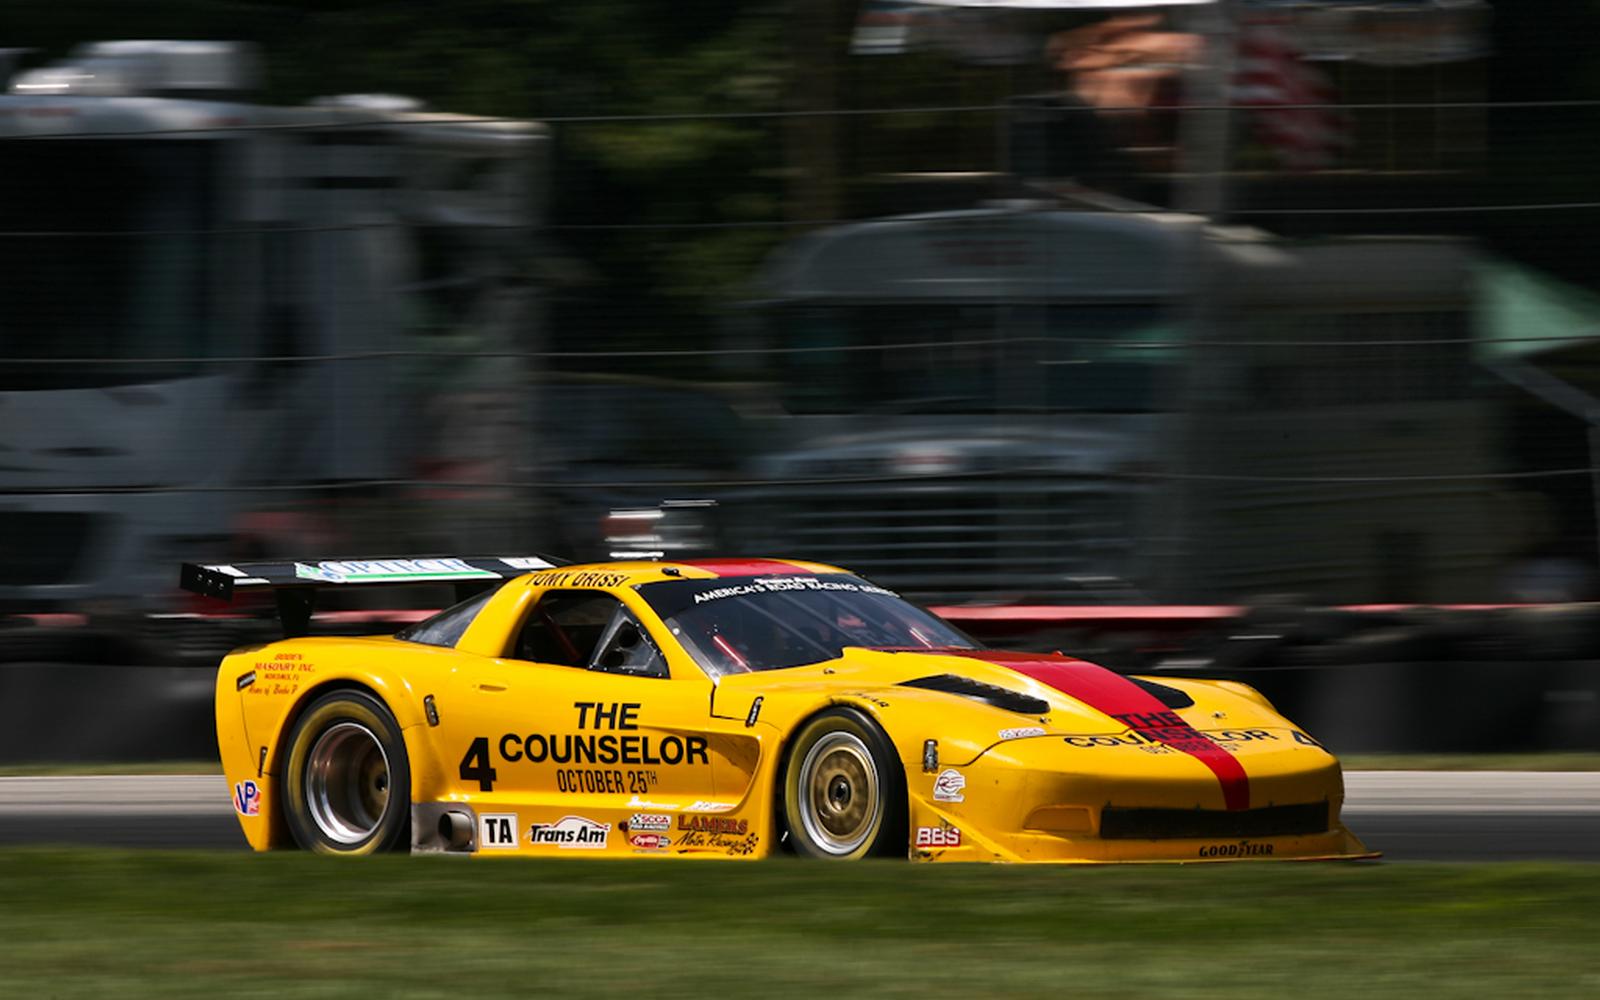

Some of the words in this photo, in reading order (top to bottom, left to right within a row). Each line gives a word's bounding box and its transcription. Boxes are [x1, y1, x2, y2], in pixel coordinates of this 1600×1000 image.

[694, 583, 766, 604] AMERICA'S
[806, 581, 859, 592] RACING
[574, 702, 641, 730] THE
[1110, 711, 1191, 728] THE
[498, 733, 709, 765] COUNSELOR
[459, 737, 497, 792] 4
[556, 769, 624, 793] OCTOBER
[627, 770, 658, 793] 25TH
[485, 818, 513, 843] TA
[530, 825, 575, 843] Trans
[576, 825, 606, 843] Am
[677, 814, 749, 835] LAMERS
[916, 827, 960, 846] BBS
